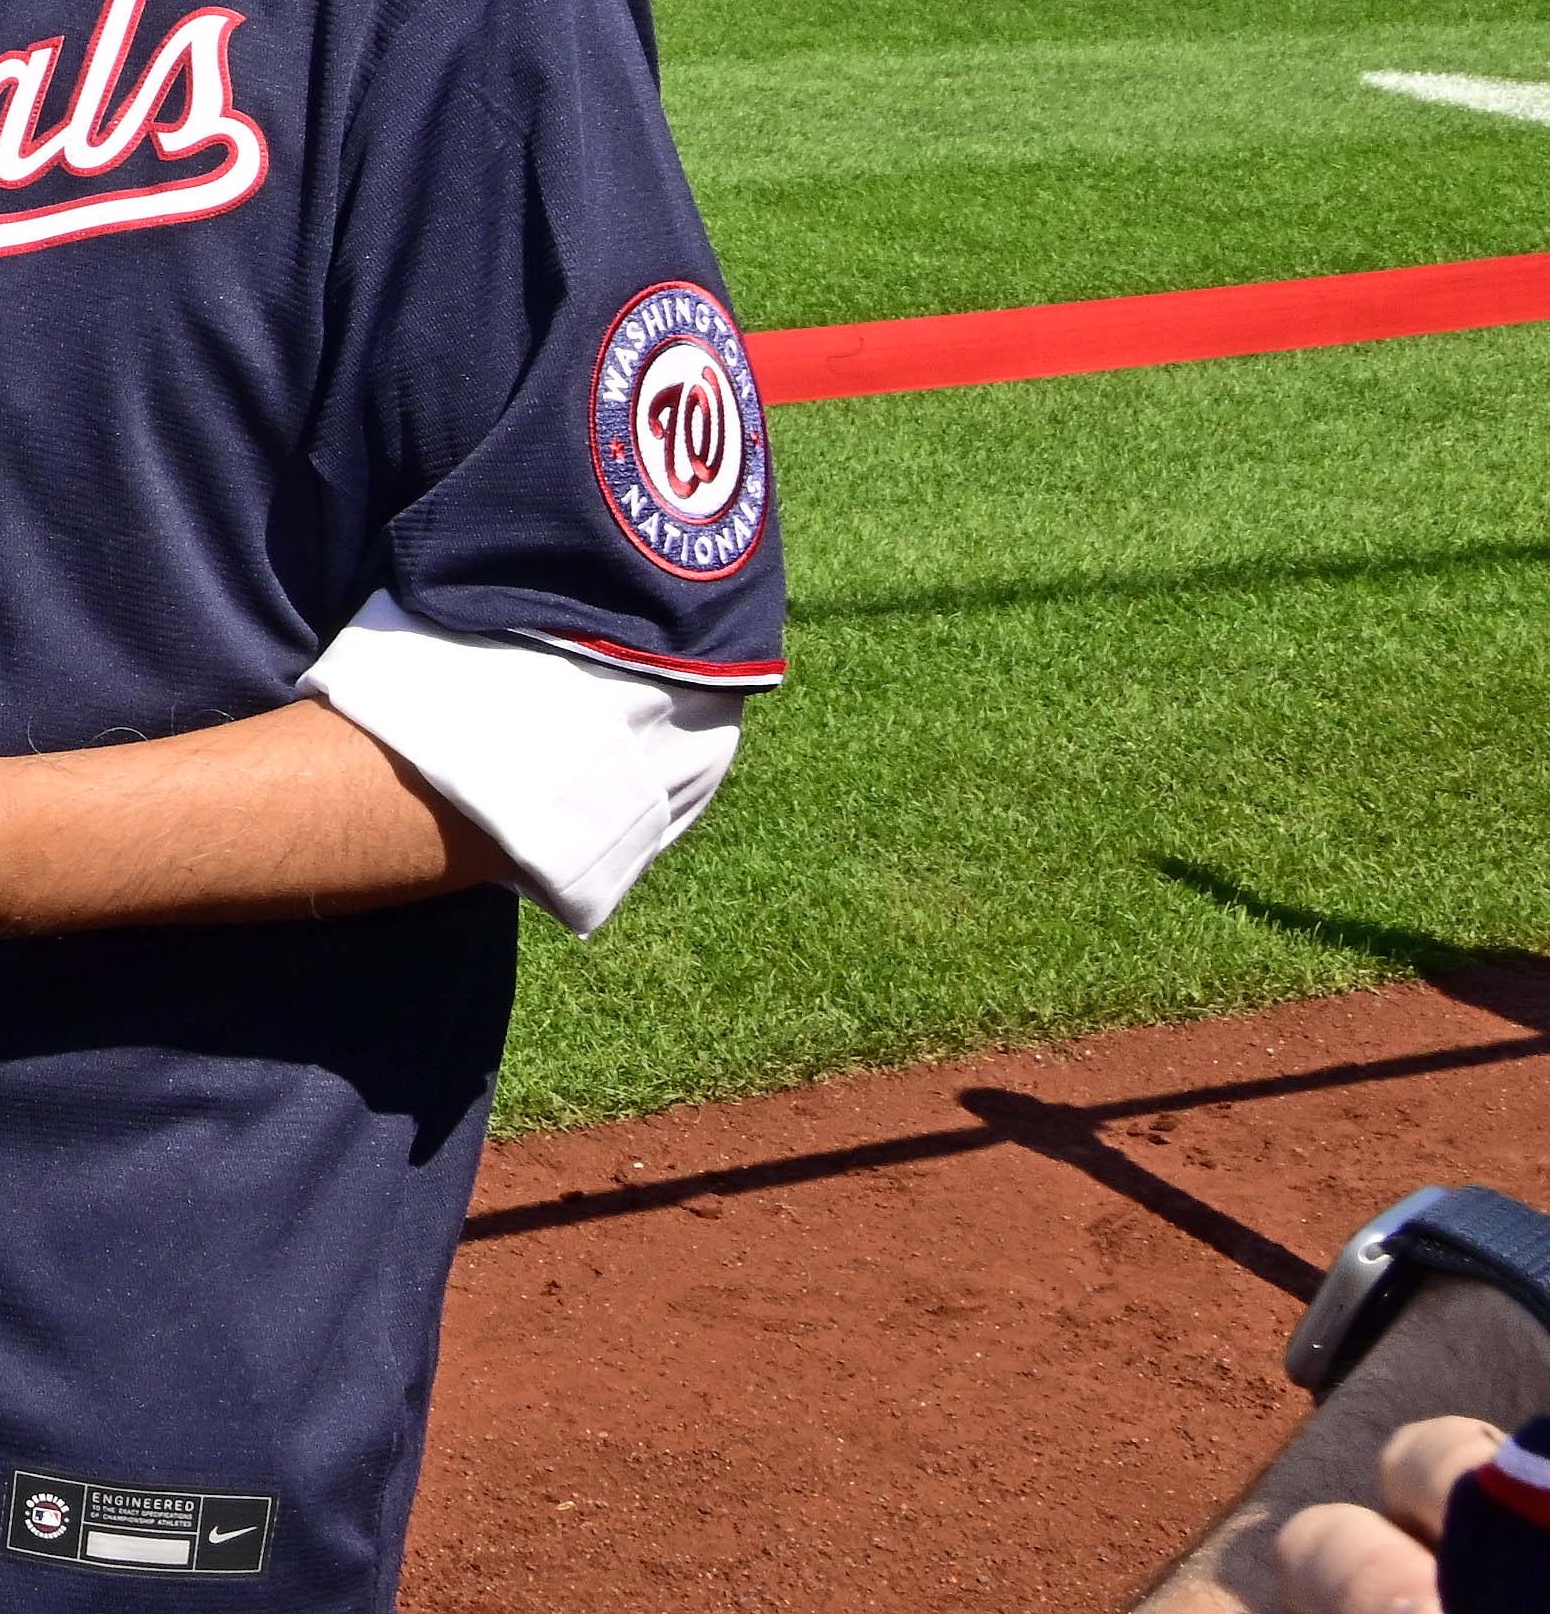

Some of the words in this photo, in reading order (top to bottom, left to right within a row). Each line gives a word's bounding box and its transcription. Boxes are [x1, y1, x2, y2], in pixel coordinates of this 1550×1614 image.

[603, 297, 752, 404] WASHINGTON
[620, 474, 763, 566] NATIONALS
[91, 1492, 195, 1512] ENGINEERED
